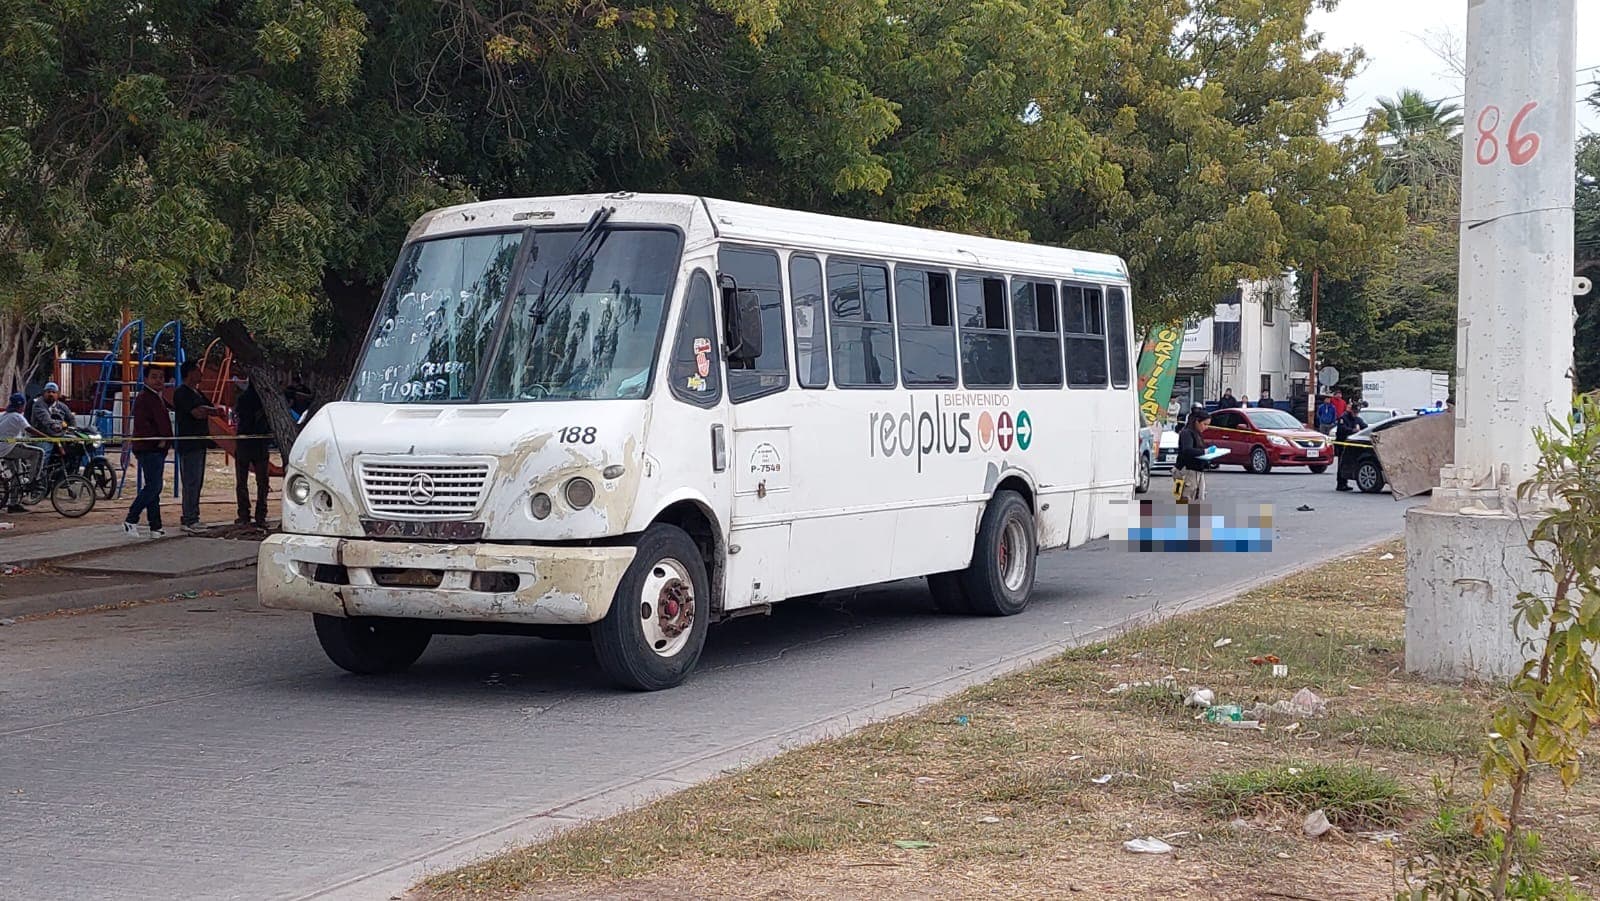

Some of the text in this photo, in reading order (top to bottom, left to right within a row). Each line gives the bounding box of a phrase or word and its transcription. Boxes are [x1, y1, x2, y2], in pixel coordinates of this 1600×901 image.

[1477, 101, 1540, 165] 86
[943, 393, 1010, 407] BIENVENIDO
[1141, 328, 1178, 425] ORTILLAS
[558, 426, 598, 445] 188
[870, 394, 971, 473] redplus
